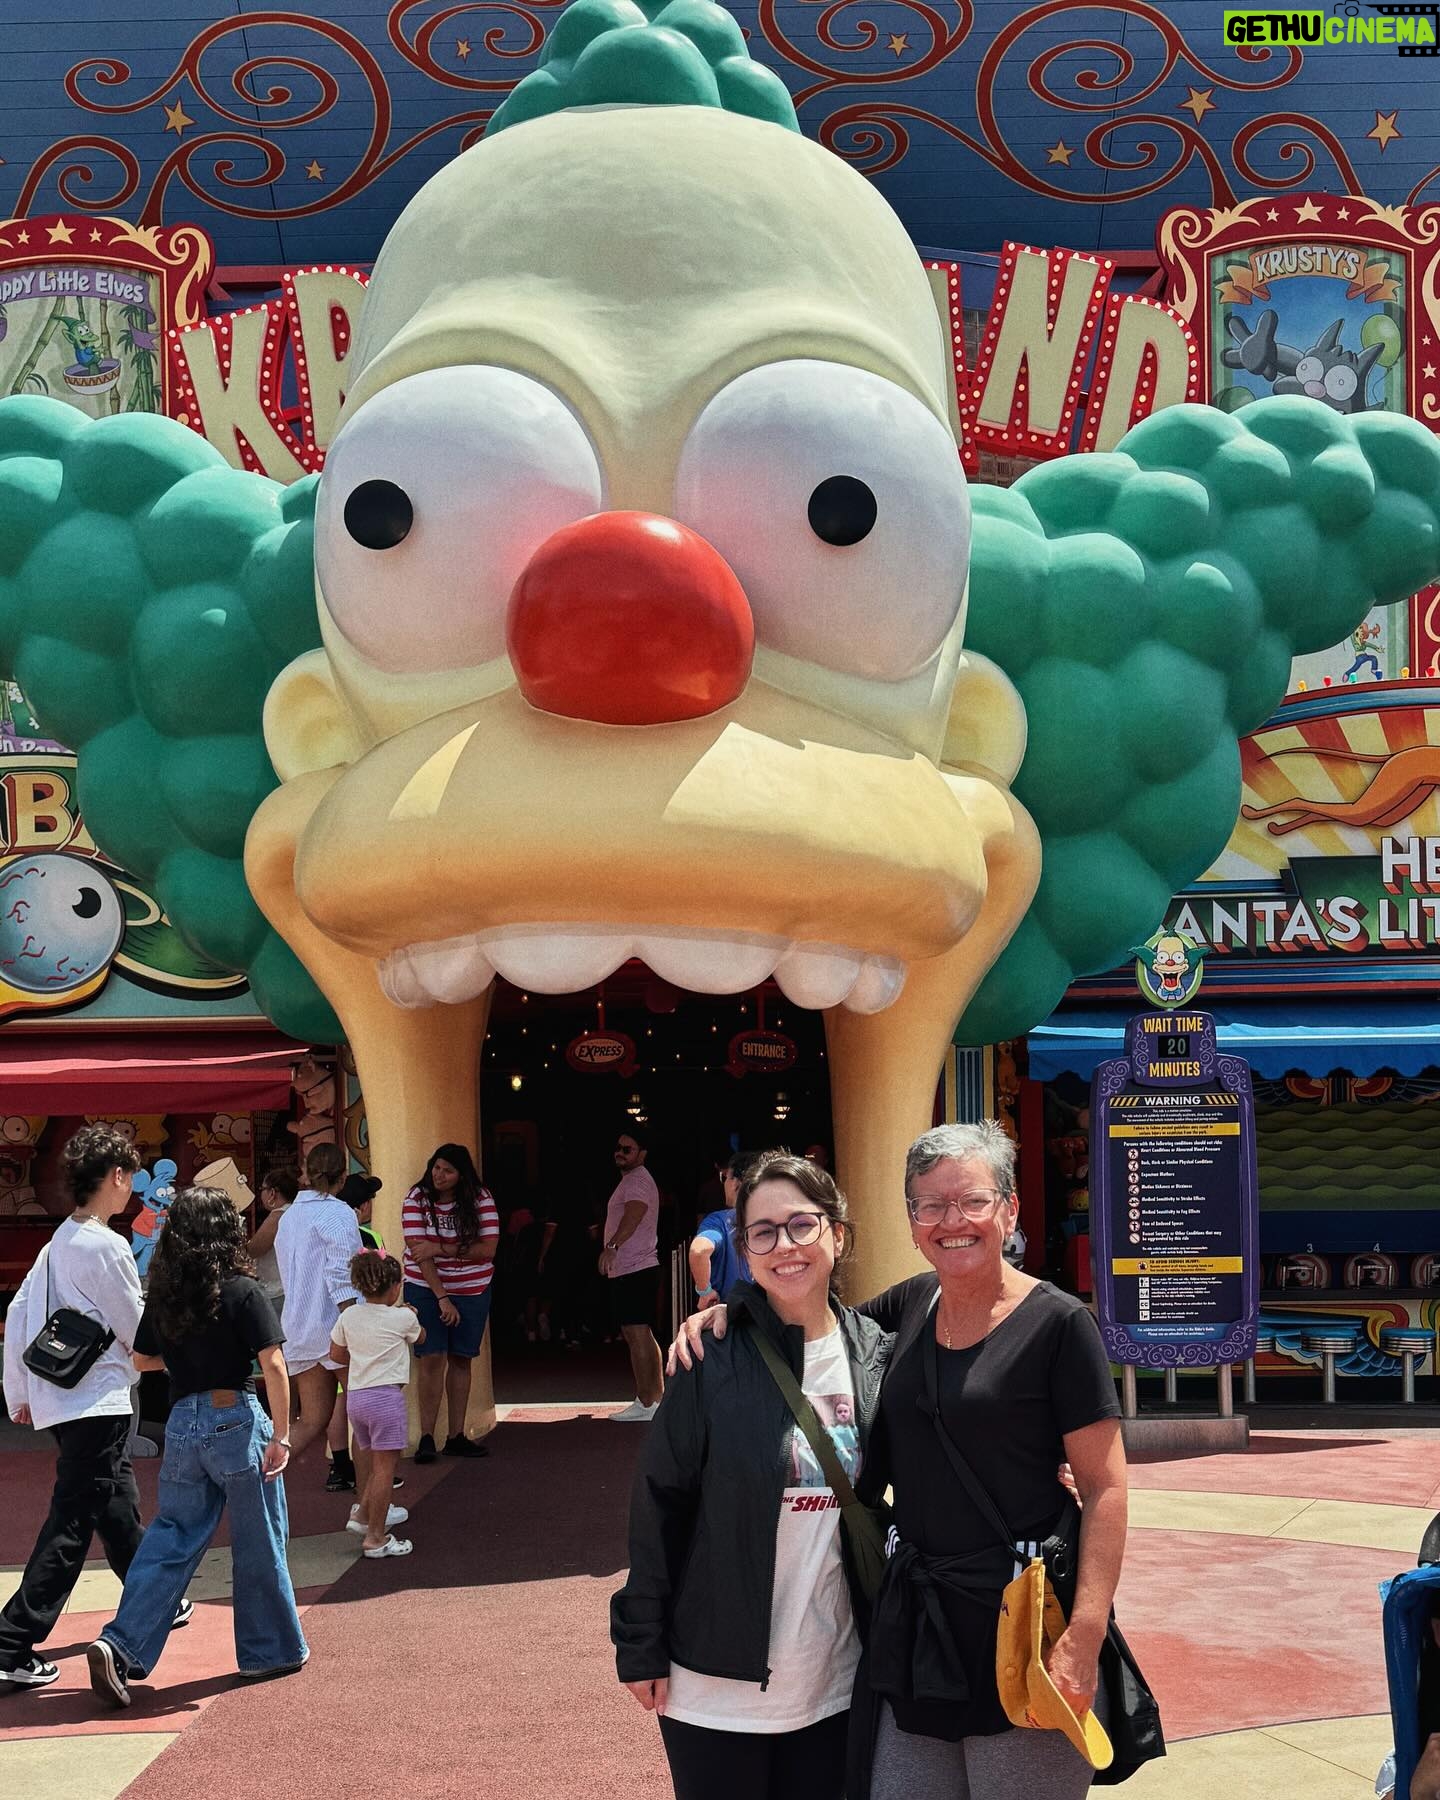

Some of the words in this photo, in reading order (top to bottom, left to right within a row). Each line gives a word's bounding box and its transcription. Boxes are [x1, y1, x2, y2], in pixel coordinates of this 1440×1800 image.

[1255, 246, 1361, 282] KRUSTY'S
[40, 270, 90, 291] Little
[95, 271, 144, 303] Elves
[1382, 837, 1440, 883] HE
[1159, 896, 1362, 945] ANTA'S
[1379, 898, 1440, 940] LIT
[1144, 1018, 1172, 1033] WAIT
[1176, 1016, 1203, 1032] TIME
[578, 1045, 622, 1061] EXPRESS
[742, 1042, 786, 1059] ENTRANCE
[1168, 1038, 1186, 1054] 20
[1149, 1062, 1200, 1077] MINUTES
[1144, 1096, 1200, 1106] WARNING
[1307, 1244, 1313, 1253] 3
[1373, 1243, 1380, 1253] 4
